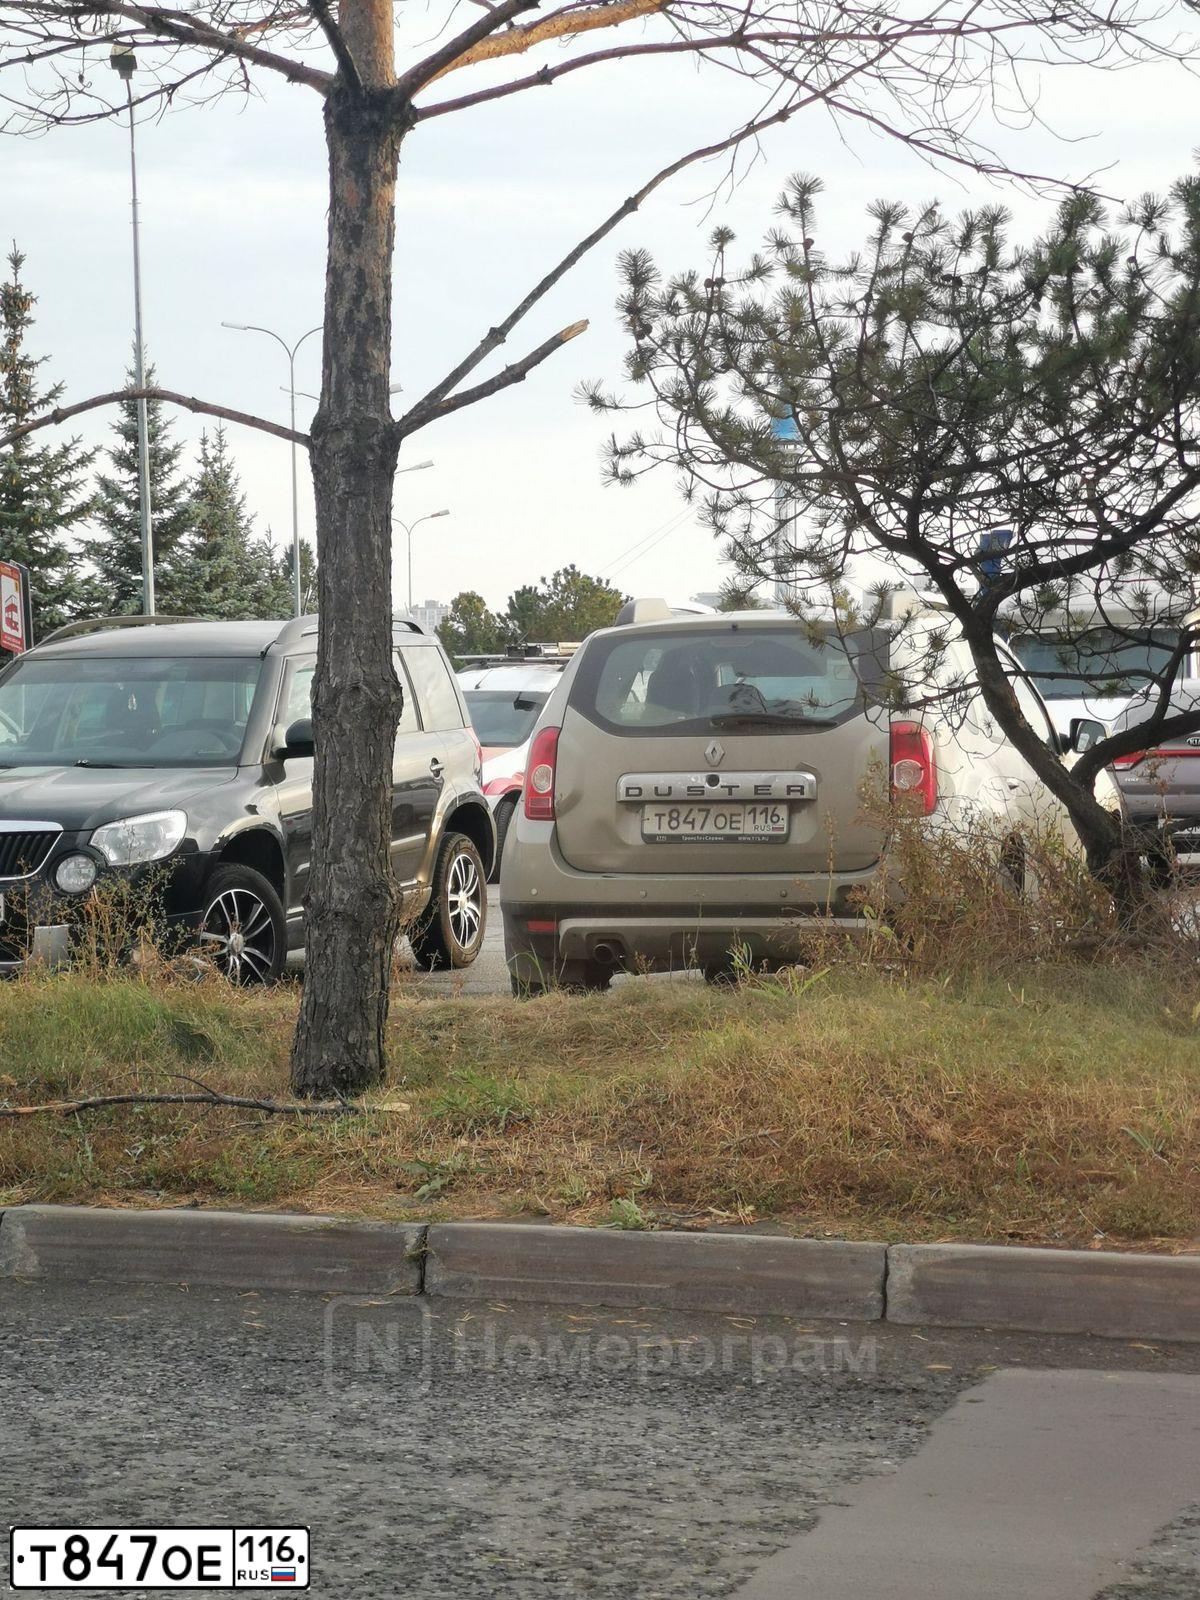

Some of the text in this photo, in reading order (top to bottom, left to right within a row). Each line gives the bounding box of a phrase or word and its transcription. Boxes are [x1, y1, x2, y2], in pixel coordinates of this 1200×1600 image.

[625, 784, 805, 797] DUSTER
[747, 807, 780, 824] 116
[754, 824, 771, 832] RUS
